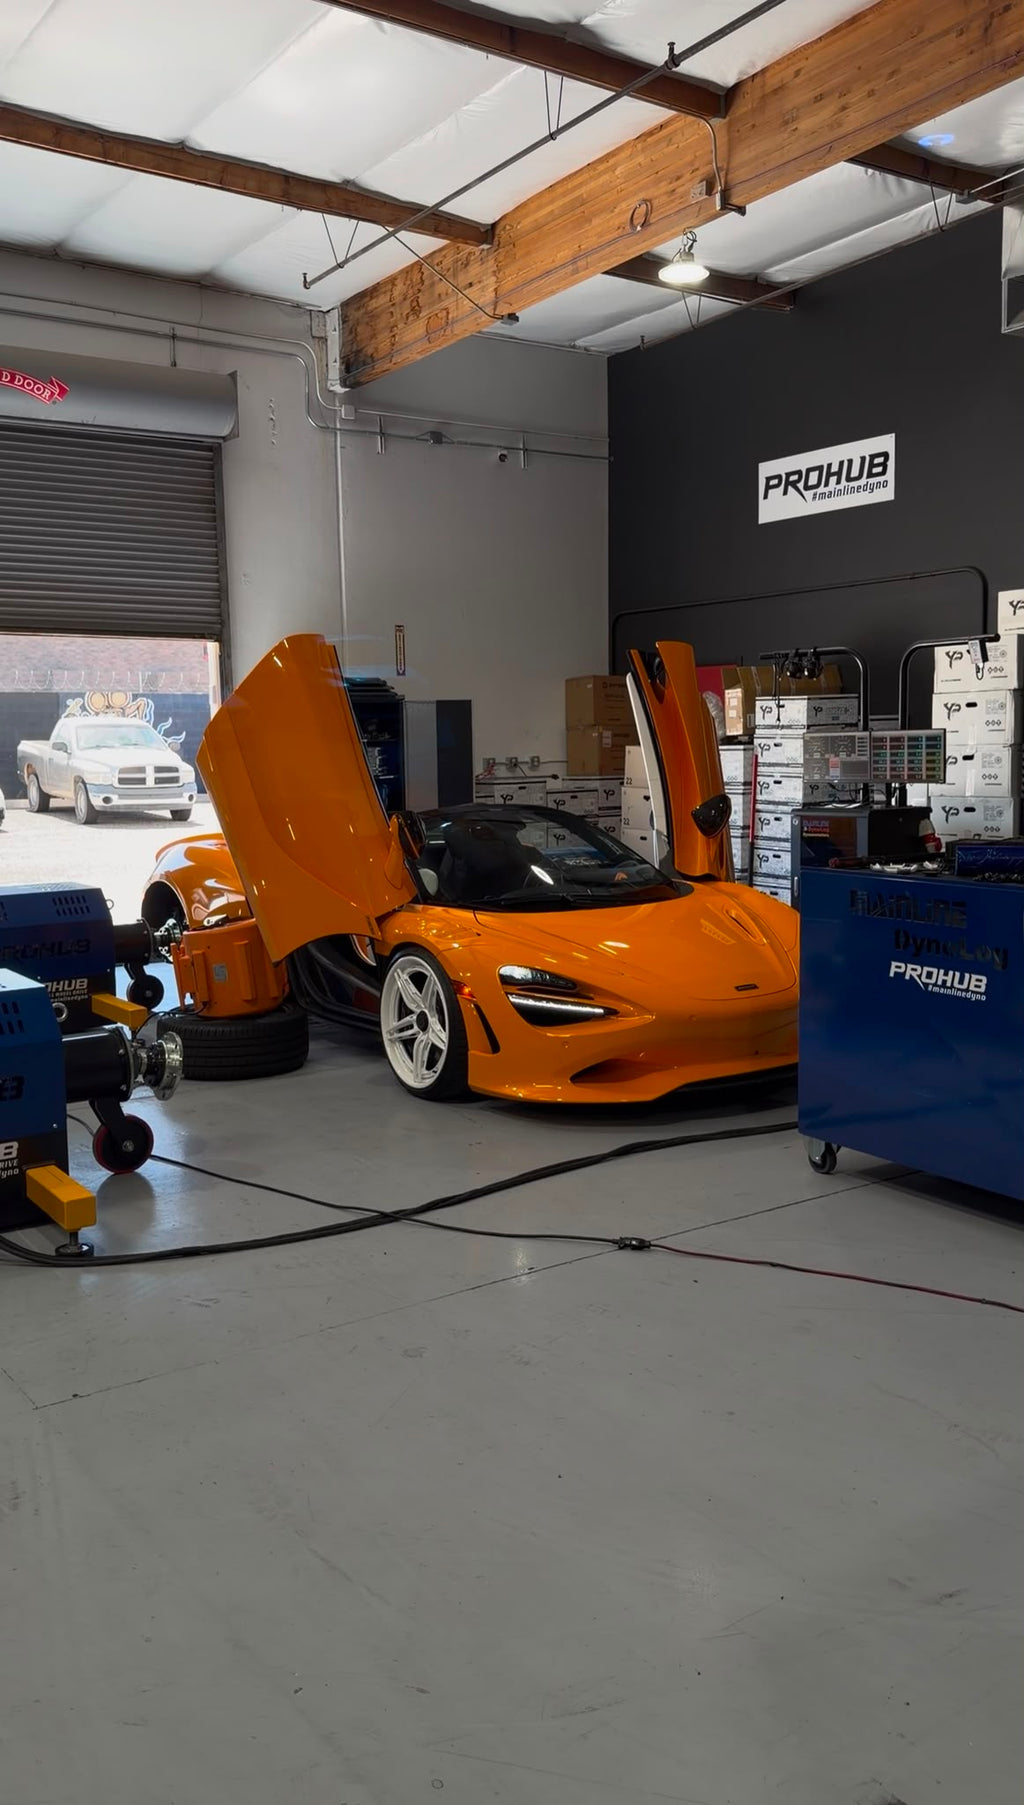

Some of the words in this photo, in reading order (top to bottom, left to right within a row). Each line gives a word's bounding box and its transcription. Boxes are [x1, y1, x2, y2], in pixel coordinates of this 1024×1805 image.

[14, 374, 52, 400] DOOR
[763, 451, 890, 503] PROHUB
[811, 479, 889, 502] #mainlinedyno
[625, 776, 633, 785] 22
[623, 817, 630, 826] 22
[888, 961, 988, 993] PROHUB
[927, 984, 987, 1002] #mainlinedyno
